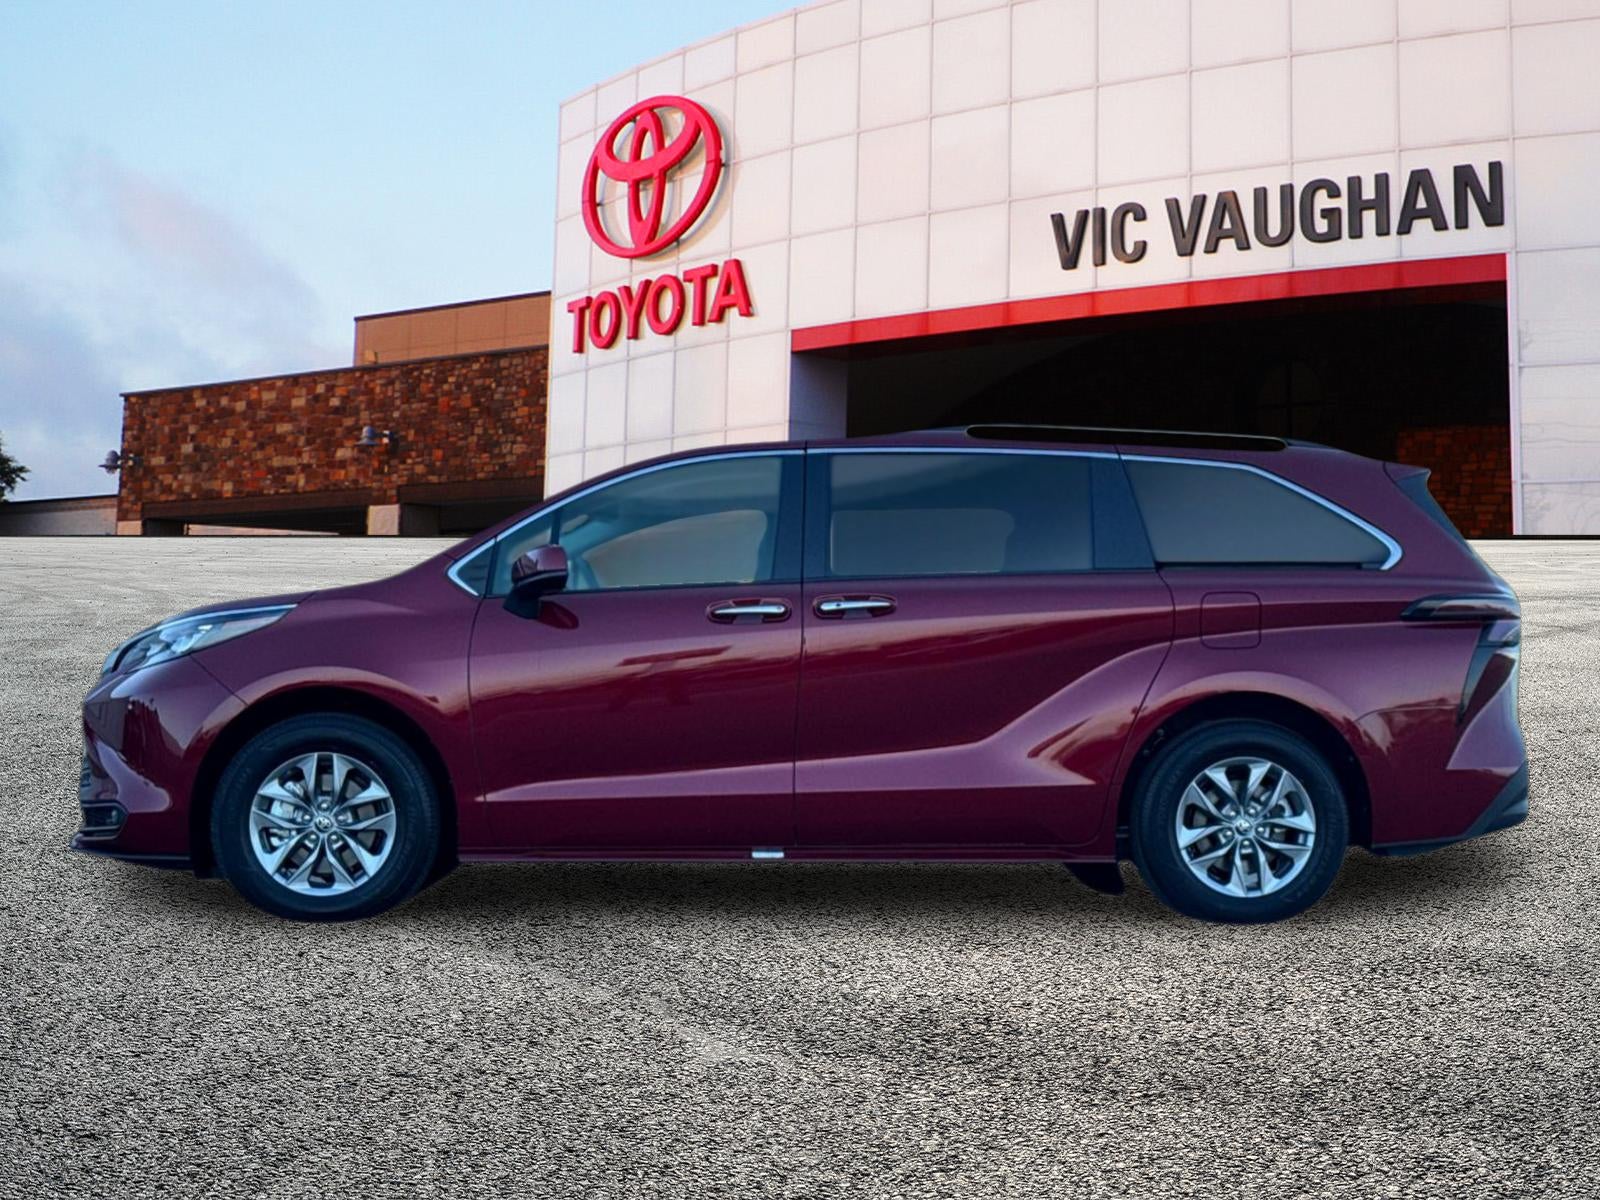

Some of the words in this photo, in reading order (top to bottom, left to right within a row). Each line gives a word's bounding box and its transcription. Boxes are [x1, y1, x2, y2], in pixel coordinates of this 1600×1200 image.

[1050, 201, 1148, 270] VIC
[1165, 161, 1505, 257] VAUGHAN
[567, 258, 754, 353] TOYOTA
